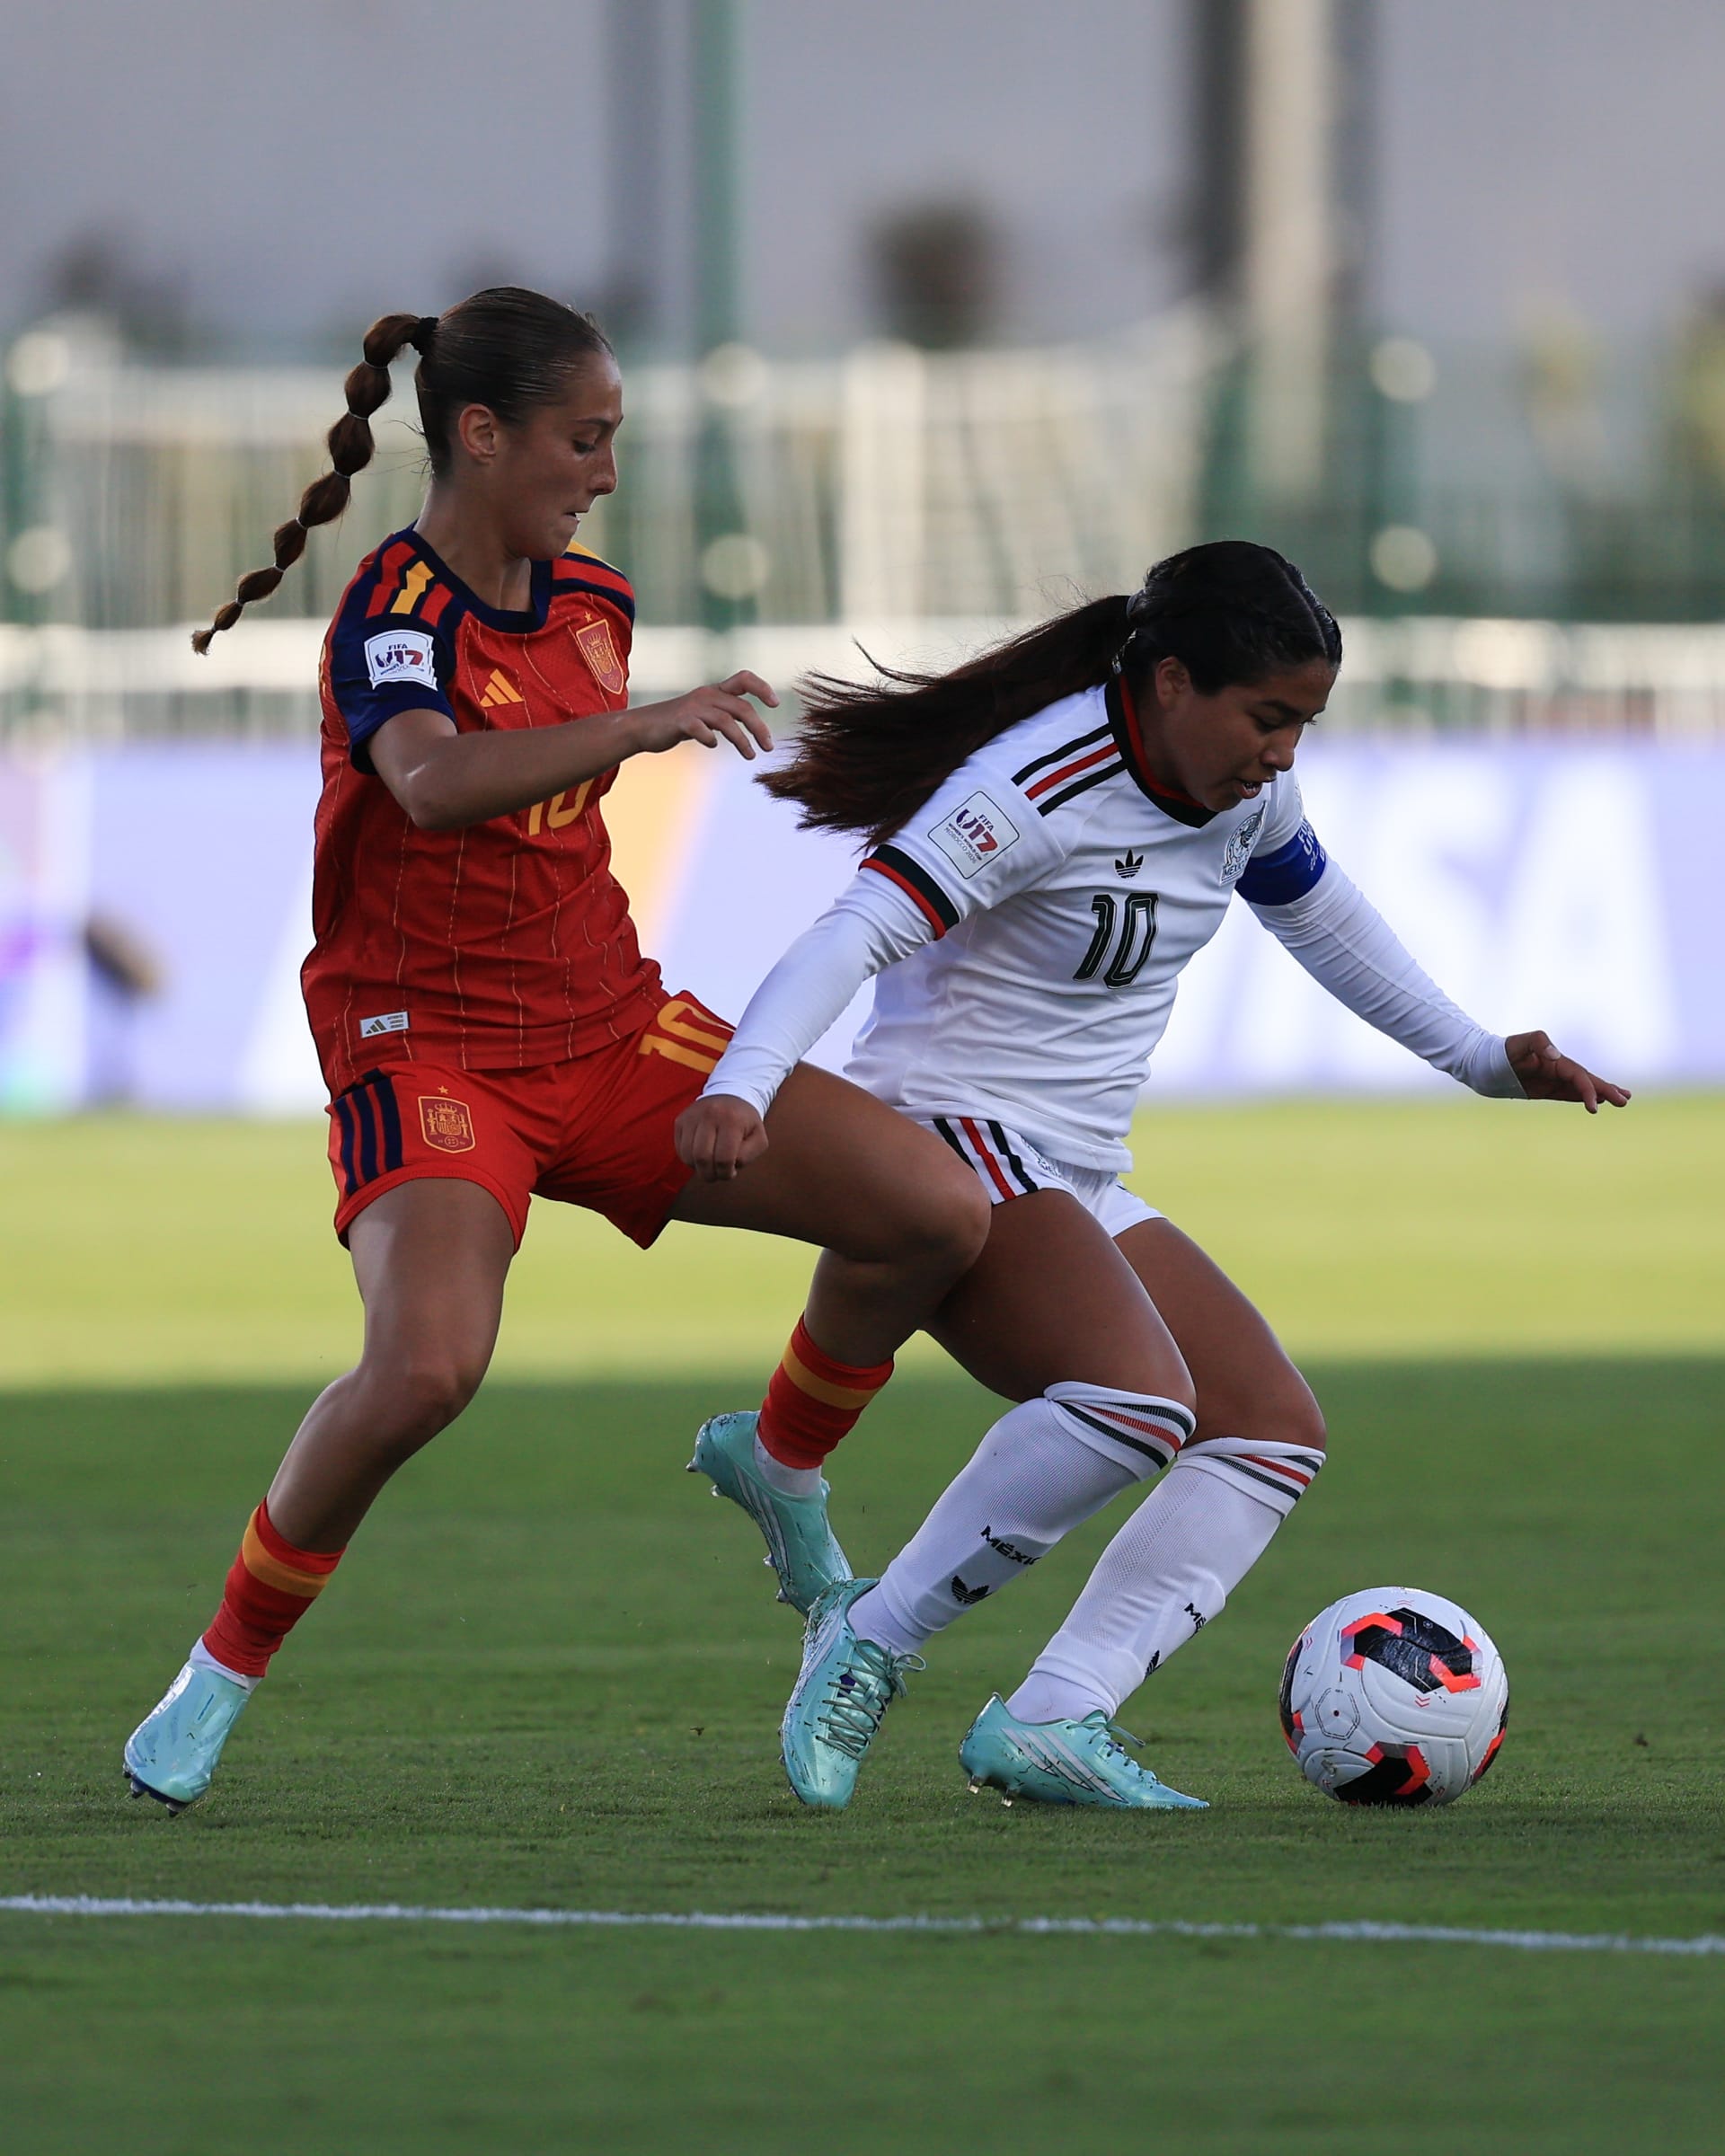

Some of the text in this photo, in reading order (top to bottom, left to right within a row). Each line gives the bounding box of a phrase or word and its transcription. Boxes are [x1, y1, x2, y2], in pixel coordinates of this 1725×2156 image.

[375, 649, 423, 667] U17
[943, 826, 968, 852] MOROCCO
[956, 808, 998, 853] U17
[978, 814, 994, 832] FIFA
[1073, 892, 1159, 989] 10
[638, 1000, 736, 1074] 10
